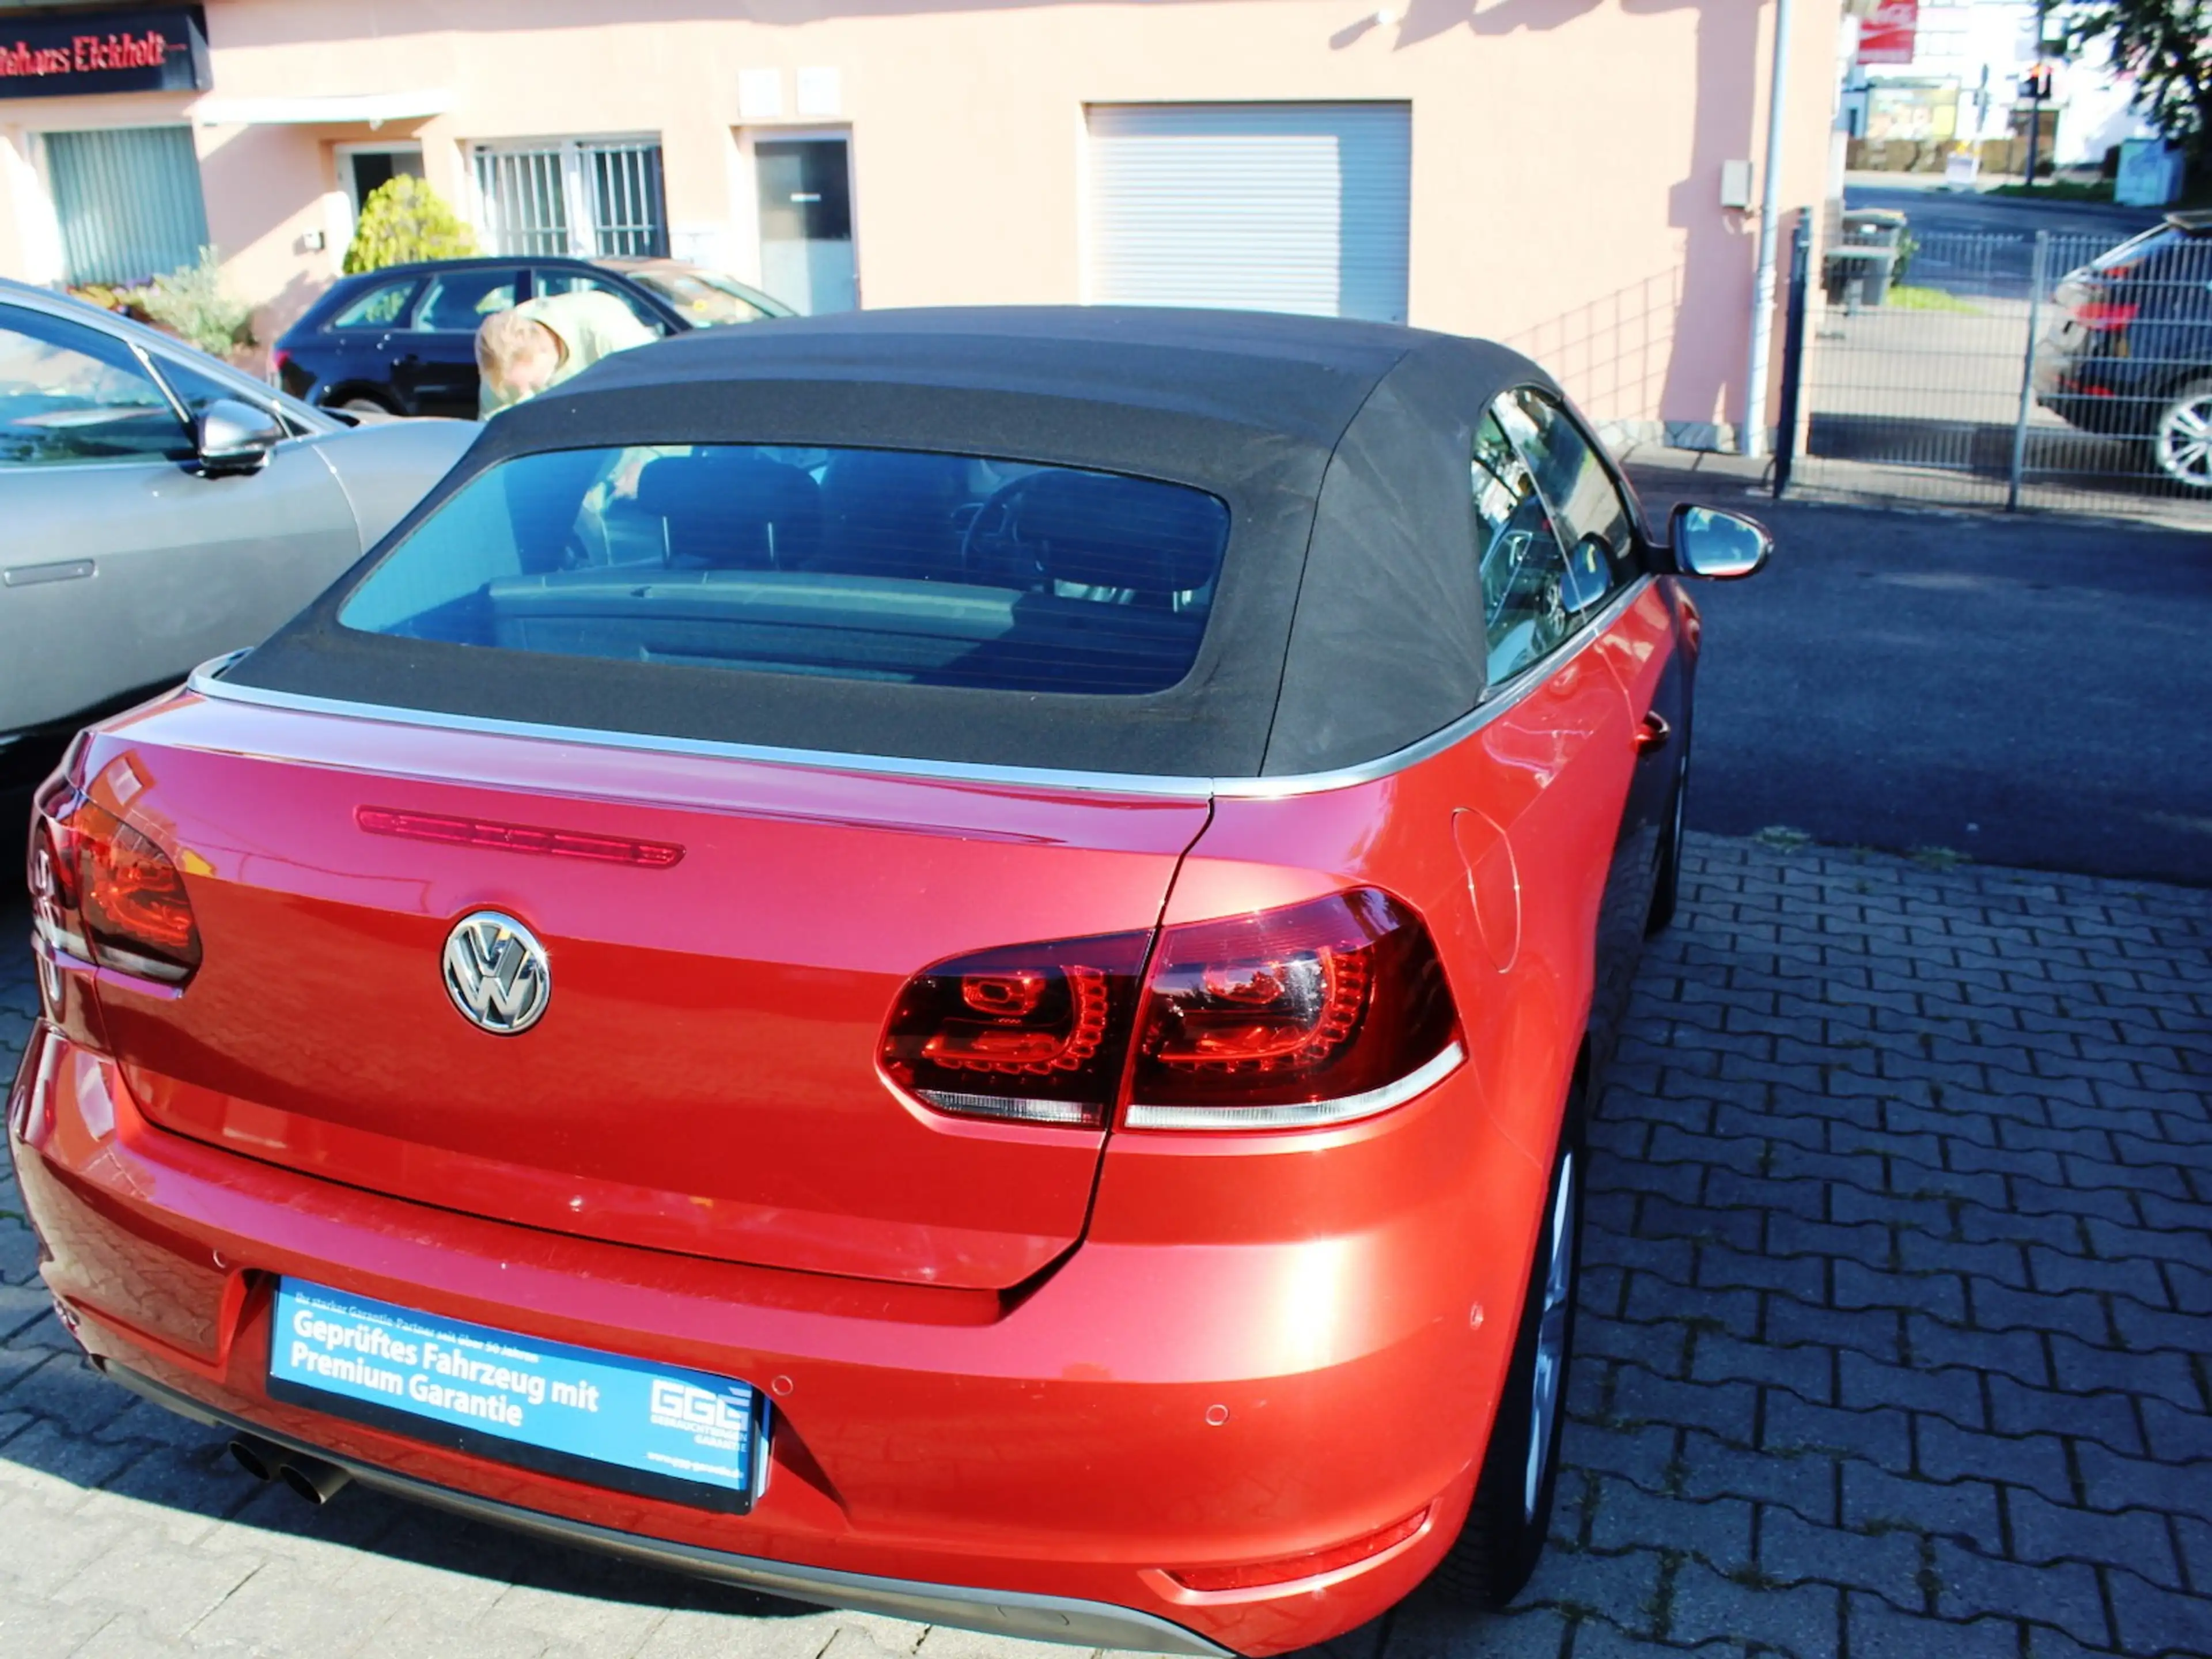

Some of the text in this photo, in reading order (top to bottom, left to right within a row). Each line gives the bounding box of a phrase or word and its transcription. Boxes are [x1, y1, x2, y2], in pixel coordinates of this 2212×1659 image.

[444, 914, 549, 1032] VW
[311, 1298, 347, 1315] starker
[291, 1340, 523, 1427] Premium Garantie
[293, 1309, 599, 1412] Geprüftes Fahrzeug mit
[650, 1414, 748, 1442] GEBRAUCHTWAGEN
[651, 1379, 752, 1431] GGG
[694, 1434, 747, 1452] GARANTIE
